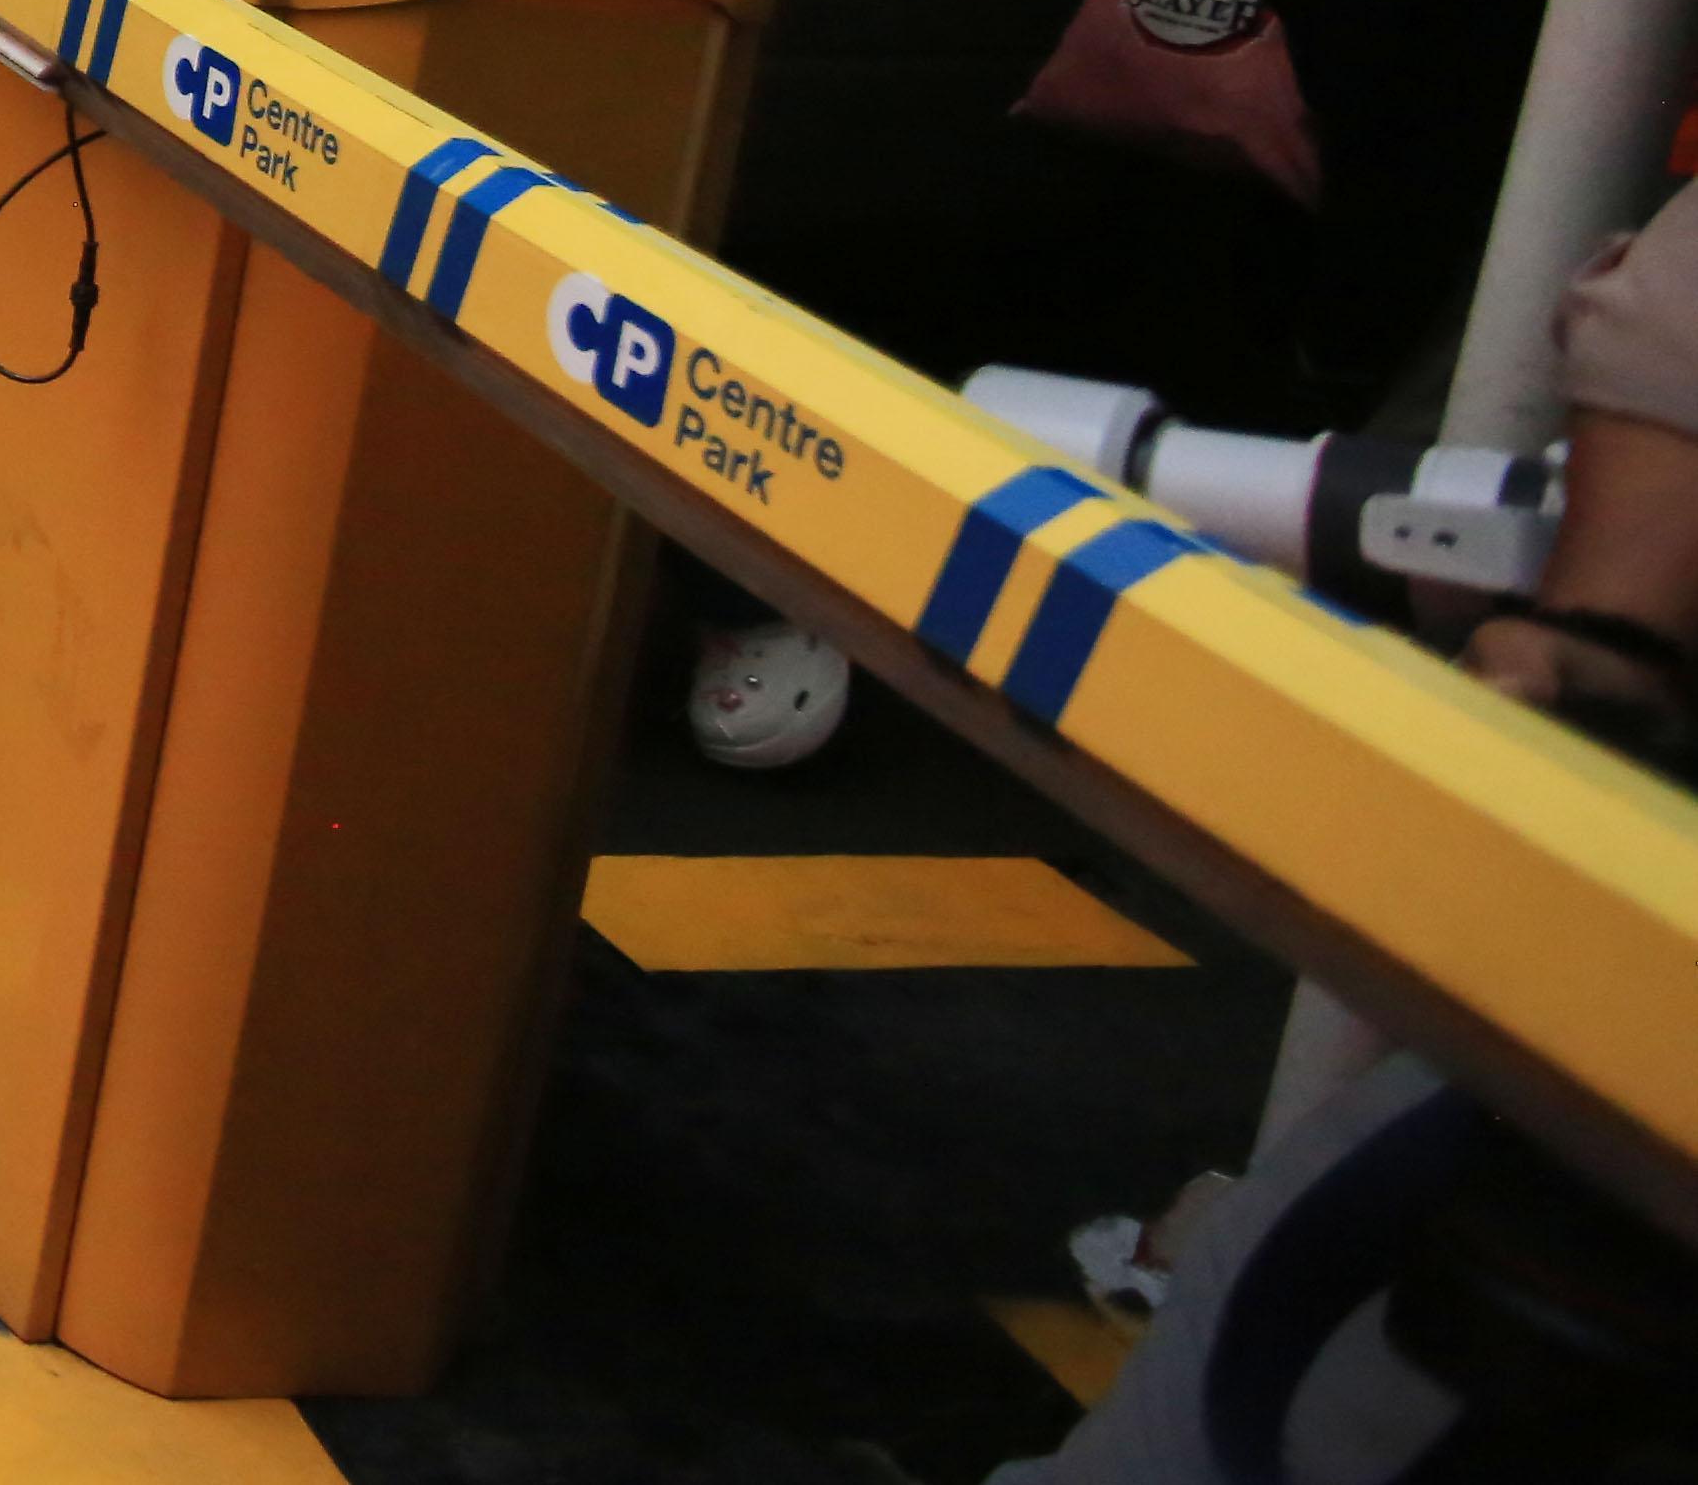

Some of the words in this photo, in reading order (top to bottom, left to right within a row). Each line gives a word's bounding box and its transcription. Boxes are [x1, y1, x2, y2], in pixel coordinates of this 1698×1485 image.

[240, 125, 299, 192] Park
[247, 79, 339, 165] Centre
[674, 405, 775, 505] Park
[687, 347, 844, 480] Centre
